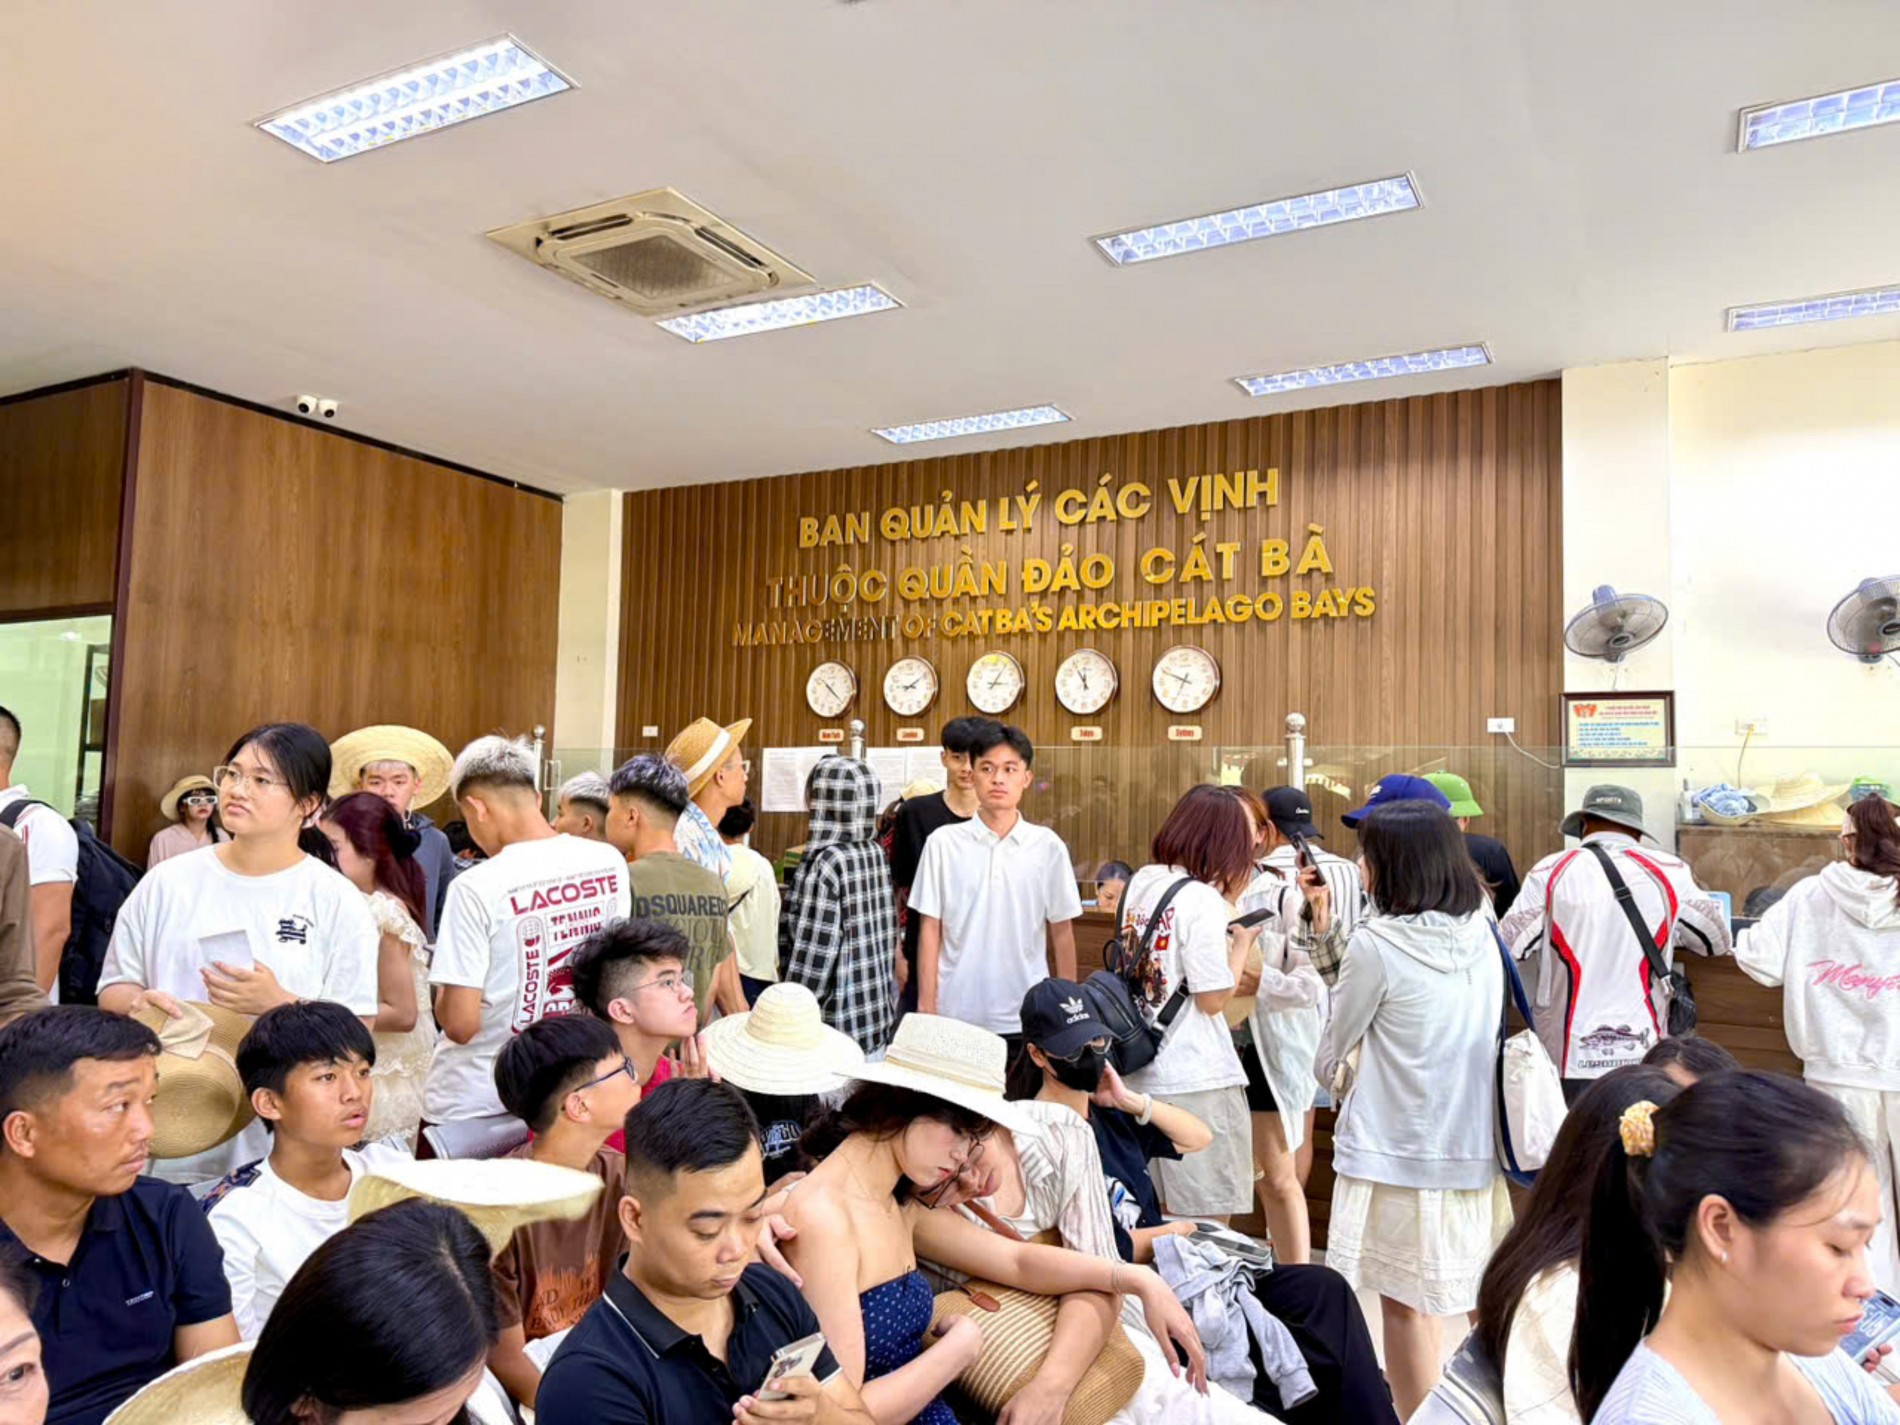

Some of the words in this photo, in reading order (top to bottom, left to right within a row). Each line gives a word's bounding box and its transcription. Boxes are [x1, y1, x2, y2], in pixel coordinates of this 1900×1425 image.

[799, 511, 870, 548] BAN
[880, 490, 987, 541] QUẢN
[999, 479, 1041, 531] LÝ
[1055, 473, 1152, 525] CÁC
[1168, 468, 1279, 521] VỊNH
[766, 564, 887, 613] THUỘC
[898, 544, 1007, 602] QUẦN
[1021, 543, 1115, 593] ĐẢO
[1141, 532, 1241, 584] CÁT
[1261, 522, 1333, 577] BÀ
[731, 615, 899, 647] MANAGEMENT
[901, 612, 937, 639] OF
[1058, 593, 1283, 632] ARCHIPELAGO
[1291, 586, 1376, 620] BAYS
[510, 875, 618, 915] LACOSTE
[520, 949, 540, 1024] LACOSTE
[1066, 1012, 1091, 1025] adidas
